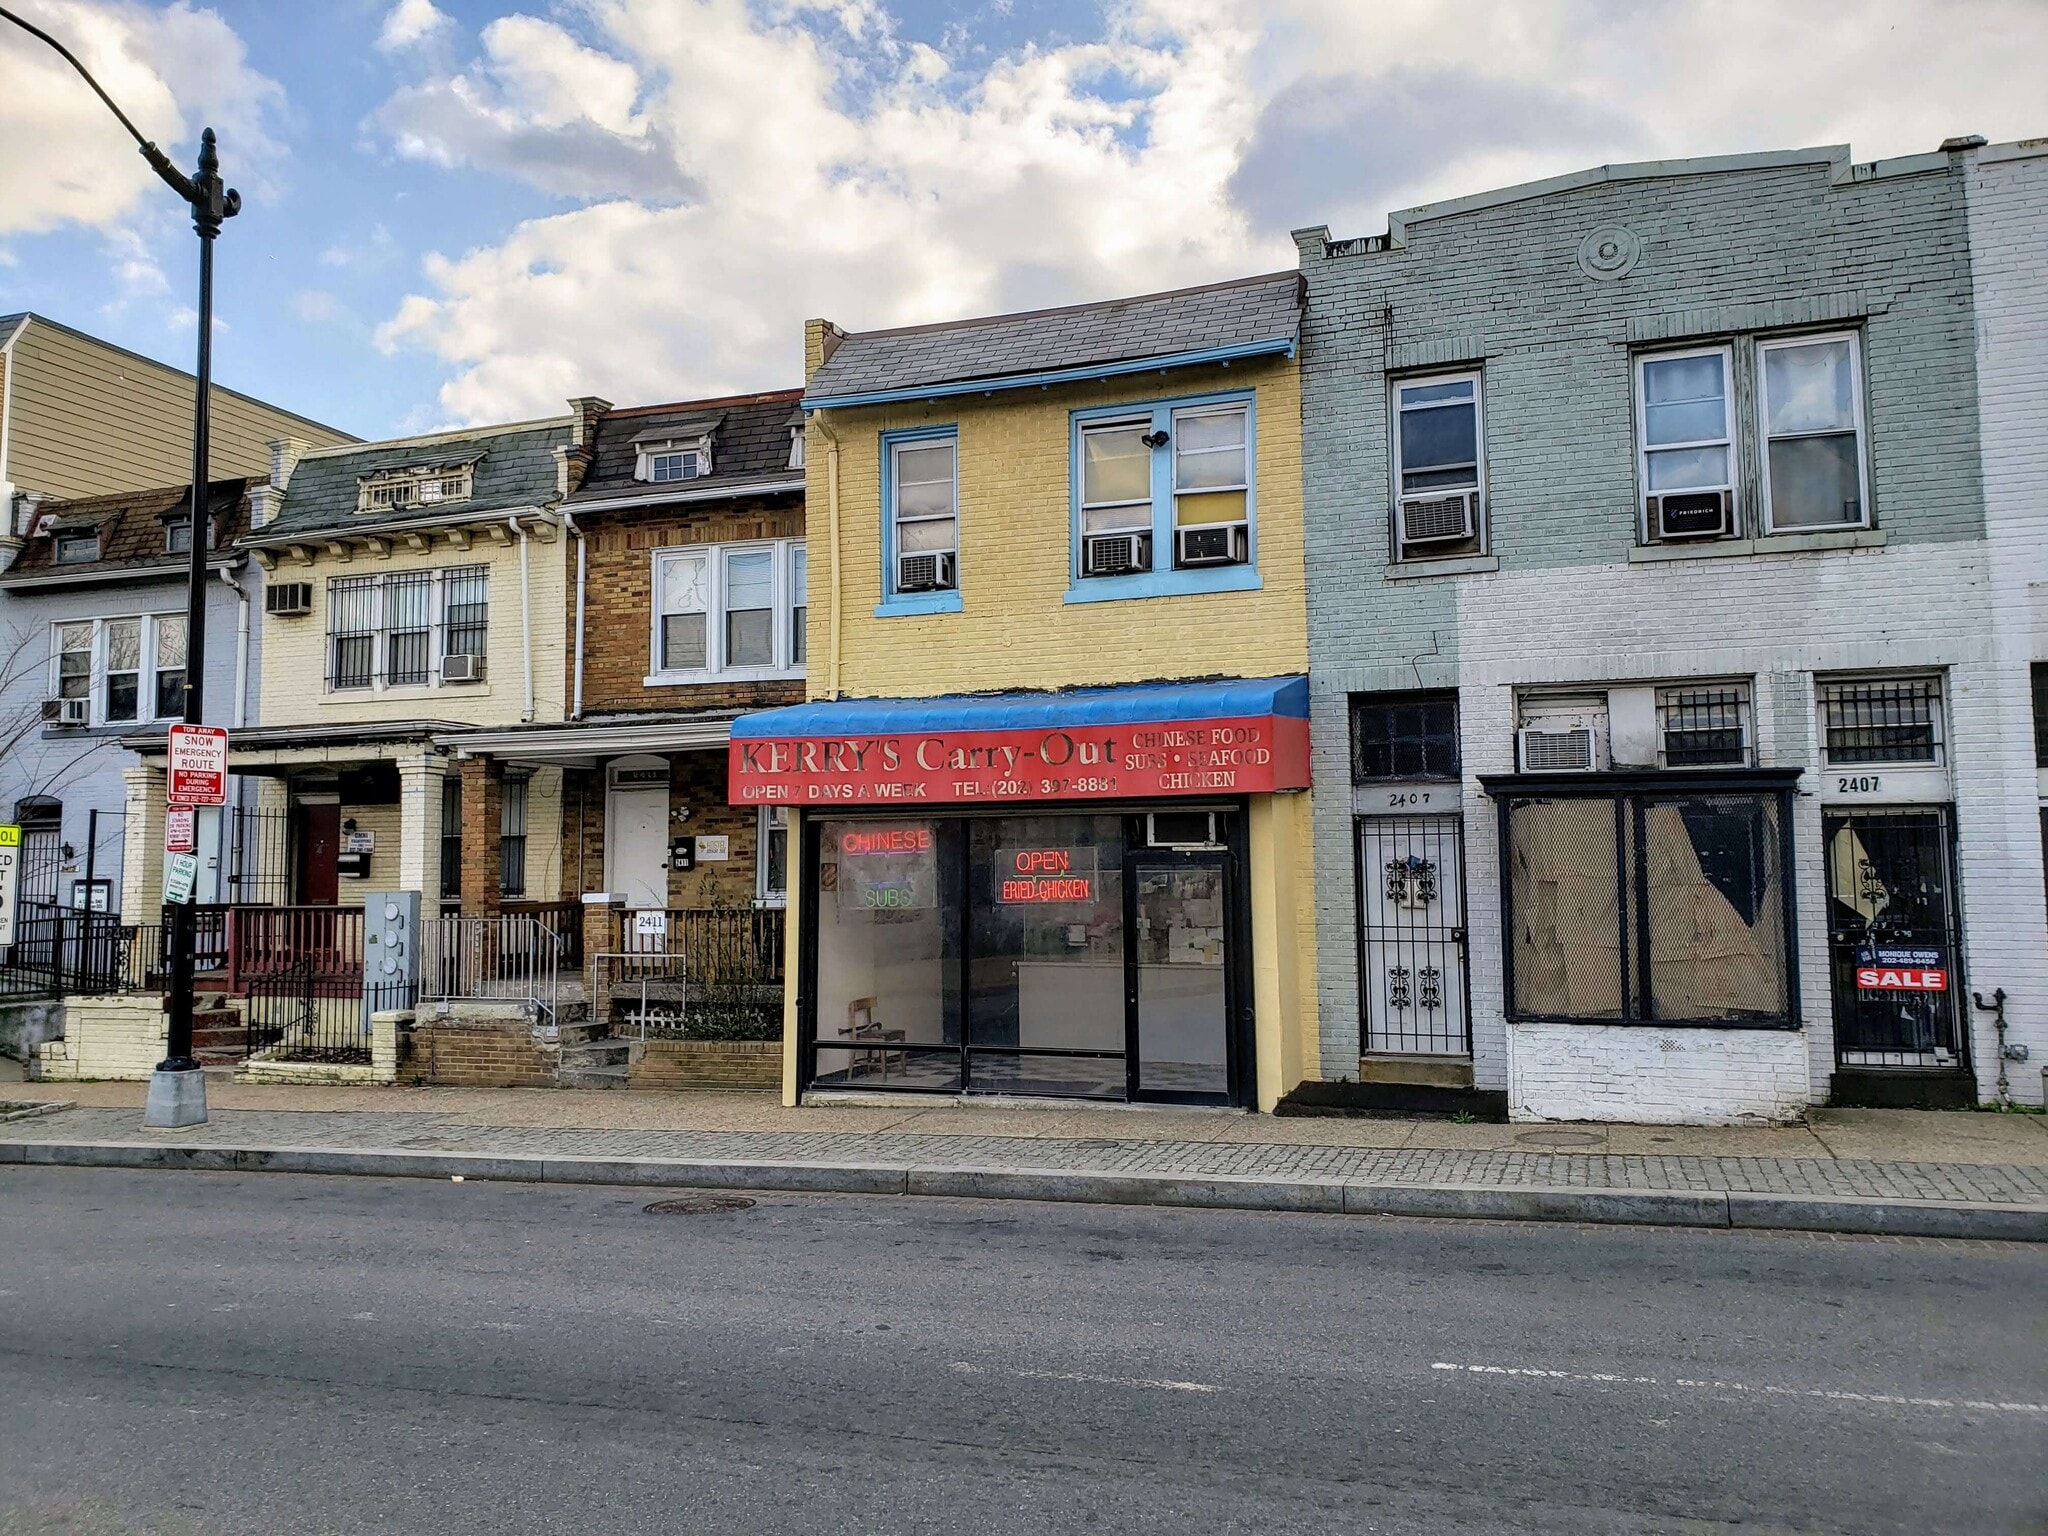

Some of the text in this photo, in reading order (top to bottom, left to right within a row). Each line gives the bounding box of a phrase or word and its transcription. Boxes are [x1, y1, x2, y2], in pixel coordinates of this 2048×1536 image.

[184, 735, 214, 746] SNOW
[1133, 728, 1260, 749] CHINESE FOOD
[174, 747, 222, 758] EMERGENCY
[739, 732, 1118, 777] KERRY'S Carry-Out
[1125, 748, 1270, 771] SUBS SEAFOOD
[181, 759, 215, 769] ROUTE
[1158, 770, 1236, 789] CHICKEN
[1838, 776, 1879, 793] 2407
[178, 785, 216, 793] EMERGENCY
[742, 784, 789, 799] OPEN
[794, 785, 802, 798] 7
[808, 783, 853, 799] DAYS
[857, 784, 871, 798] A
[874, 783, 927, 798] WEEK
[1389, 793, 1430, 807] 2407
[842, 830, 931, 852] CHINESE
[1015, 851, 1069, 872] OPEN
[864, 888, 912, 908] SUBS
[1038, 879, 1089, 900] CHICKEN
[638, 916, 663, 928] 2411
[106, 928, 133, 940] 2413
[1878, 950, 1939, 959] MONIQUE OWENS
[1860, 971, 1942, 988] SALE
